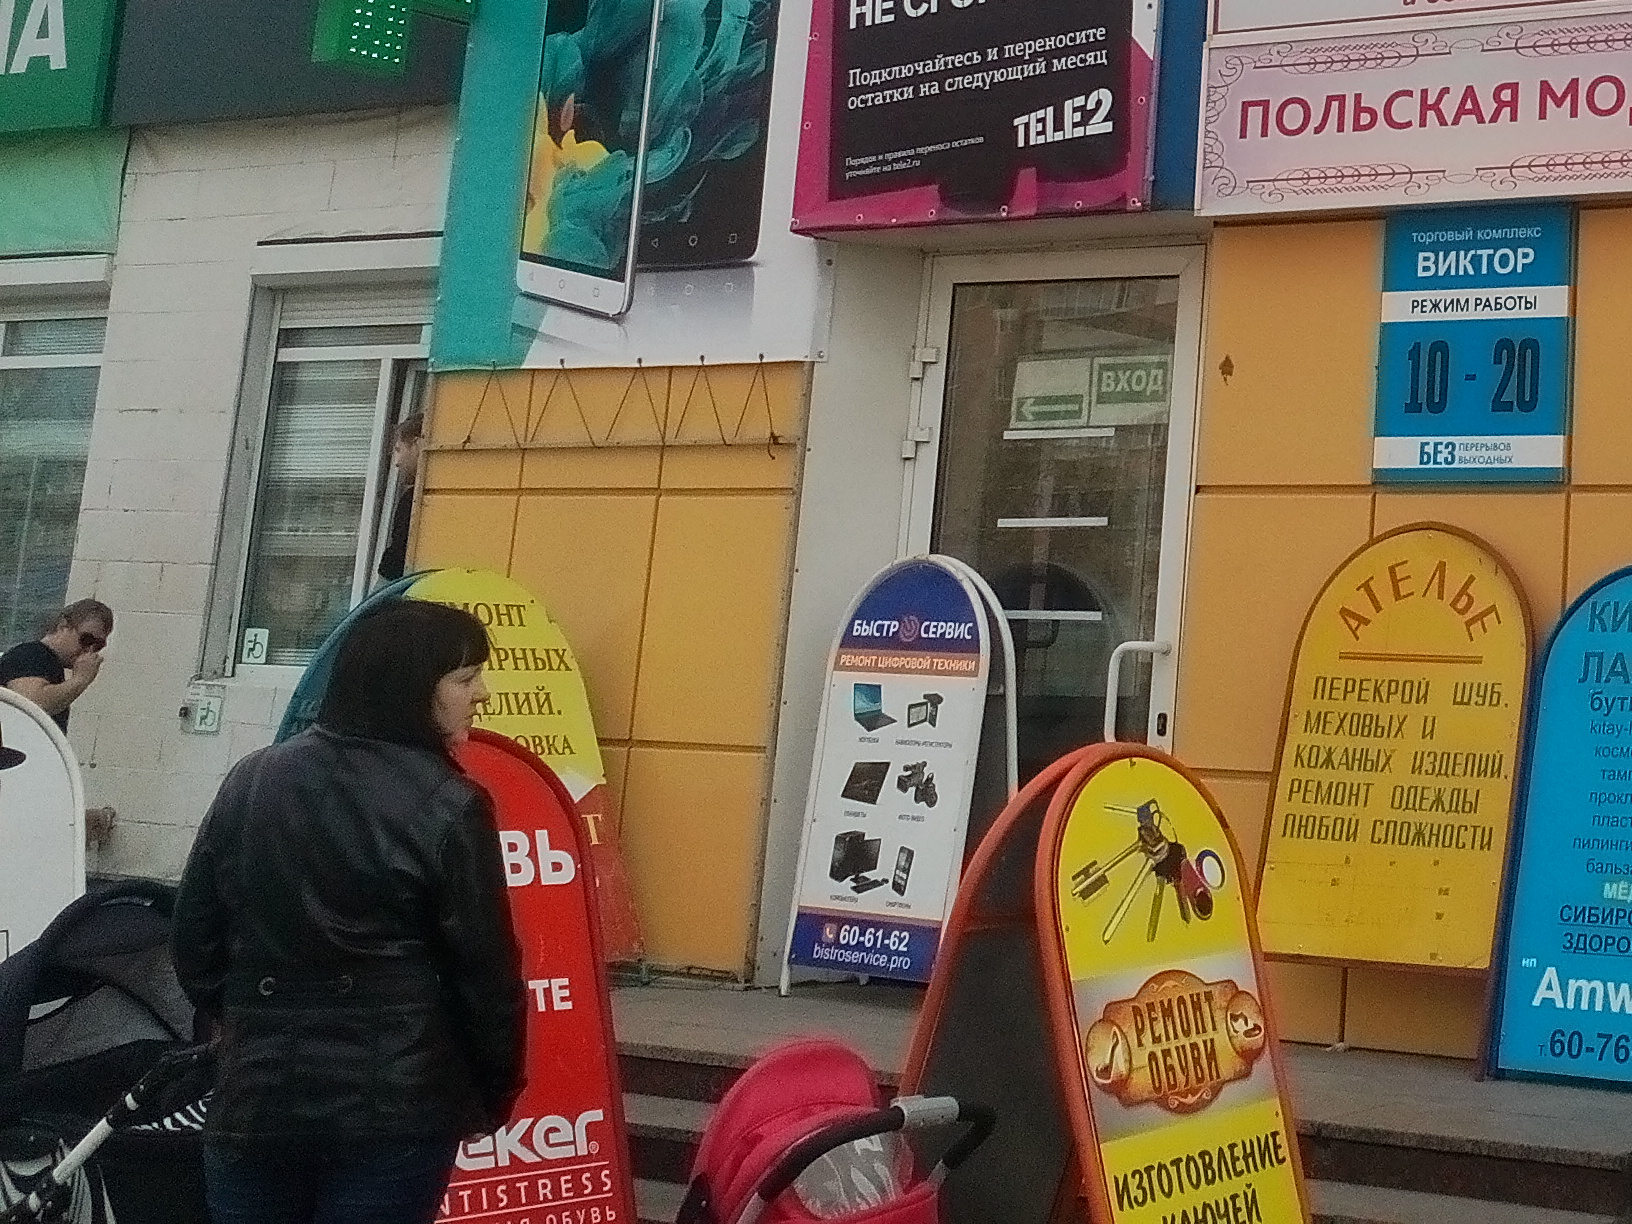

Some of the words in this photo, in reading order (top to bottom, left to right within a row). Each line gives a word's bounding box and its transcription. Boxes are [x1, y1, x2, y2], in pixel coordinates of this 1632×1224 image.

[848, 49, 981, 88] Подключайтесь
[987, 46, 998, 63] и
[1003, 25, 1107, 59] переносите
[847, 85, 914, 110] остатки
[919, 81, 940, 97] на
[944, 60, 1047, 92] следующий
[1052, 49, 1108, 75] месяц
[1013, 88, 1114, 148] TELE2
[1238, 81, 1520, 140] ПОЛЬСКАЯ
[1411, 228, 1473, 245] торговый
[1476, 226, 1542, 242] комплекс
[1417, 247, 1535, 277] ВИКТОР
[1411, 298, 1470, 314] РЕЖИМ
[1474, 295, 1538, 312] РАБОТЫ
[1101, 368, 1164, 397] ВХОД
[1404, 339, 1450, 414] 10
[1490, 337, 1540, 413] 20
[1419, 441, 1457, 466] БЕЗ
[1458, 442, 1511, 452] ПЕРЕРЫВОВ
[1458, 454, 1513, 465] ВЫХОДНЫХ
[1338, 559, 1502, 642] АТЕЛЬЕ
[920, 621, 973, 639] СЕРВИС
[840, 655, 877, 666] РЕМОНТ
[878, 656, 931, 669] ЦИФРОВОЙ
[932, 658, 976, 671] ТЕХНИКИ
[1312, 676, 1430, 706] ПЕРЕКРОЙ
[1304, 710, 1407, 740] МЕХОВЫХ
[1421, 715, 1437, 740] И
[1293, 744, 1393, 773] КОЖАНЫХ
[1287, 778, 1374, 808] РЕМОНТ
[1391, 784, 1480, 815] ОДЕЖДЫ
[1282, 813, 1360, 843] ЛЮБОЙ
[1370, 818, 1494, 852] СЛОЖНОСТИ
[840, 924, 910, 952] 60-61-62
[813, 942, 911, 971] bistroservice.pro
[1130, 989, 1218, 1049] РЕМОНТ
[1146, 1038, 1221, 1096] ОБУВИ
[1113, 1130, 1287, 1212] ИЗГОТОВЛЕНИЕ
